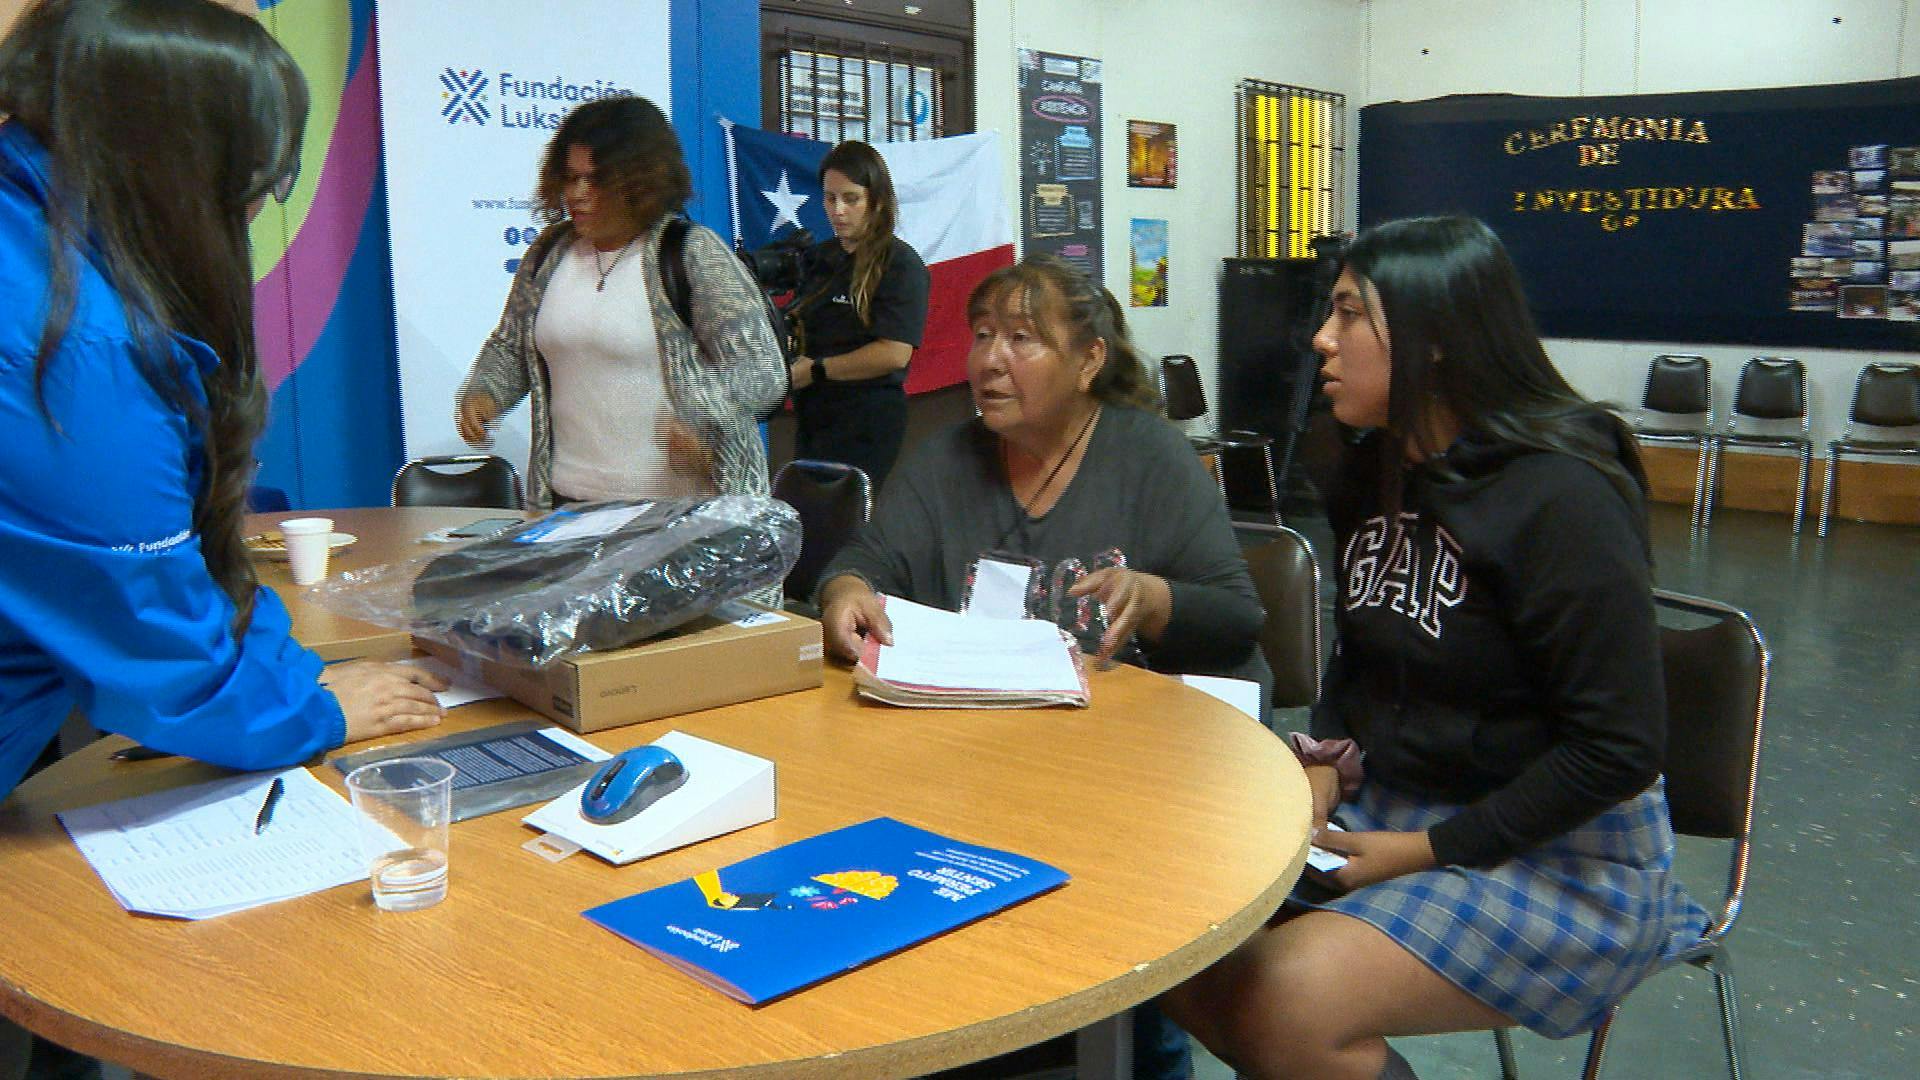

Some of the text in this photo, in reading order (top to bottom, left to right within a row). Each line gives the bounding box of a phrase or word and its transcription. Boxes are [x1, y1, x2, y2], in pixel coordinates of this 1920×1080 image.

[501, 103, 567, 129] Luksi
[1504, 116, 1710, 155] CEREMONIA
[1578, 143, 1622, 166] DE
[1513, 186, 1762, 213] INVESTIDURA
[1342, 512, 1467, 639] GAP
